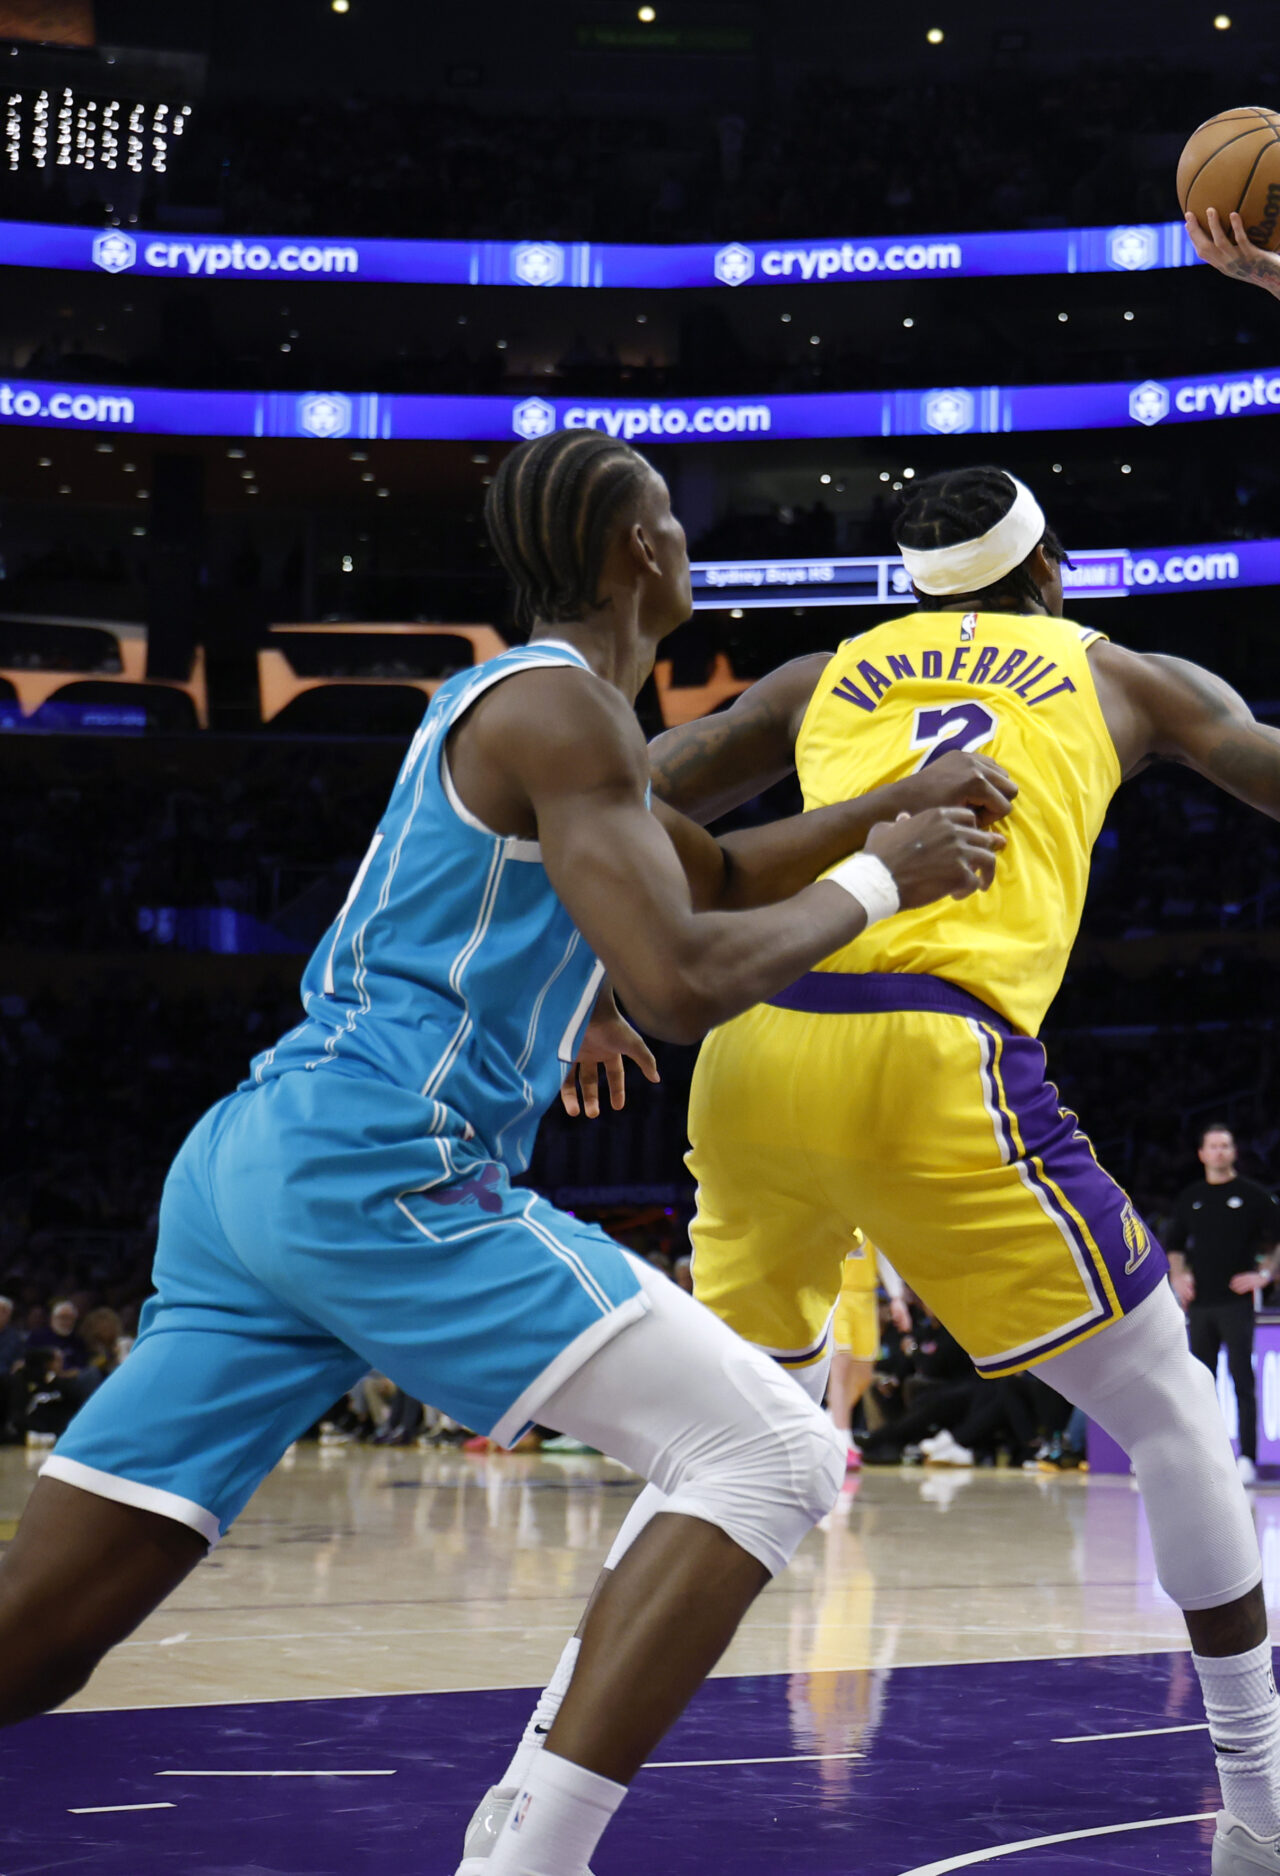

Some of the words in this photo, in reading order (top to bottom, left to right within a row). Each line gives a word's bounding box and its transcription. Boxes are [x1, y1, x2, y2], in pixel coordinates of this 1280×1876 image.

[145, 241, 358, 275] crypto.com
[761, 243, 961, 279] crypto.com
[0, 384, 134, 423] to.com
[563, 404, 771, 440] crypto.com
[831, 646, 1076, 713] VANDERBILT
